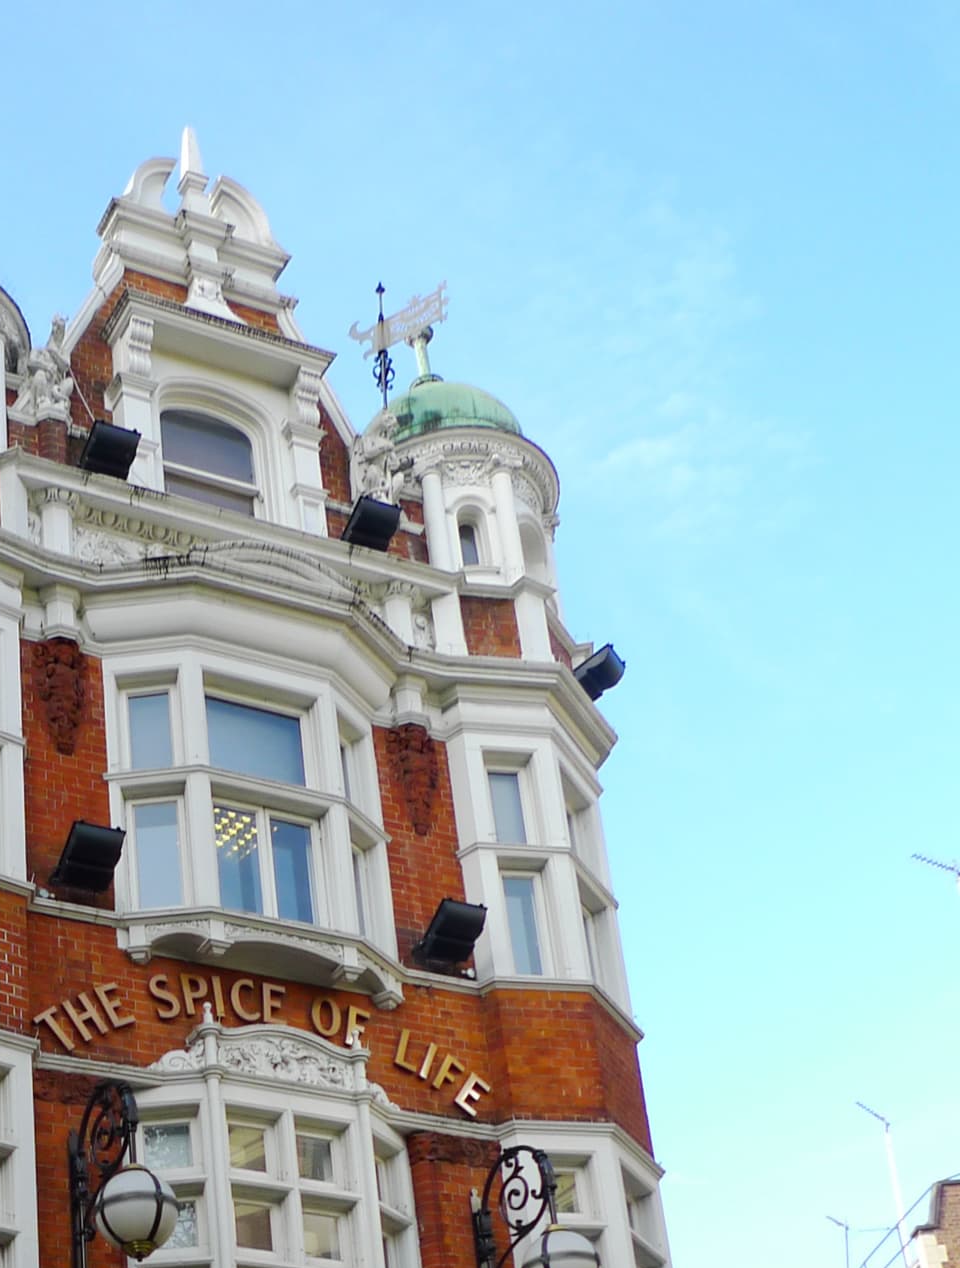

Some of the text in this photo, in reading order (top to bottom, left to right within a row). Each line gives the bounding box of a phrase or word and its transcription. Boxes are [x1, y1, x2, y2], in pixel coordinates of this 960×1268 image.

[34, 973, 491, 1117] THE SPICE OF LIFE
